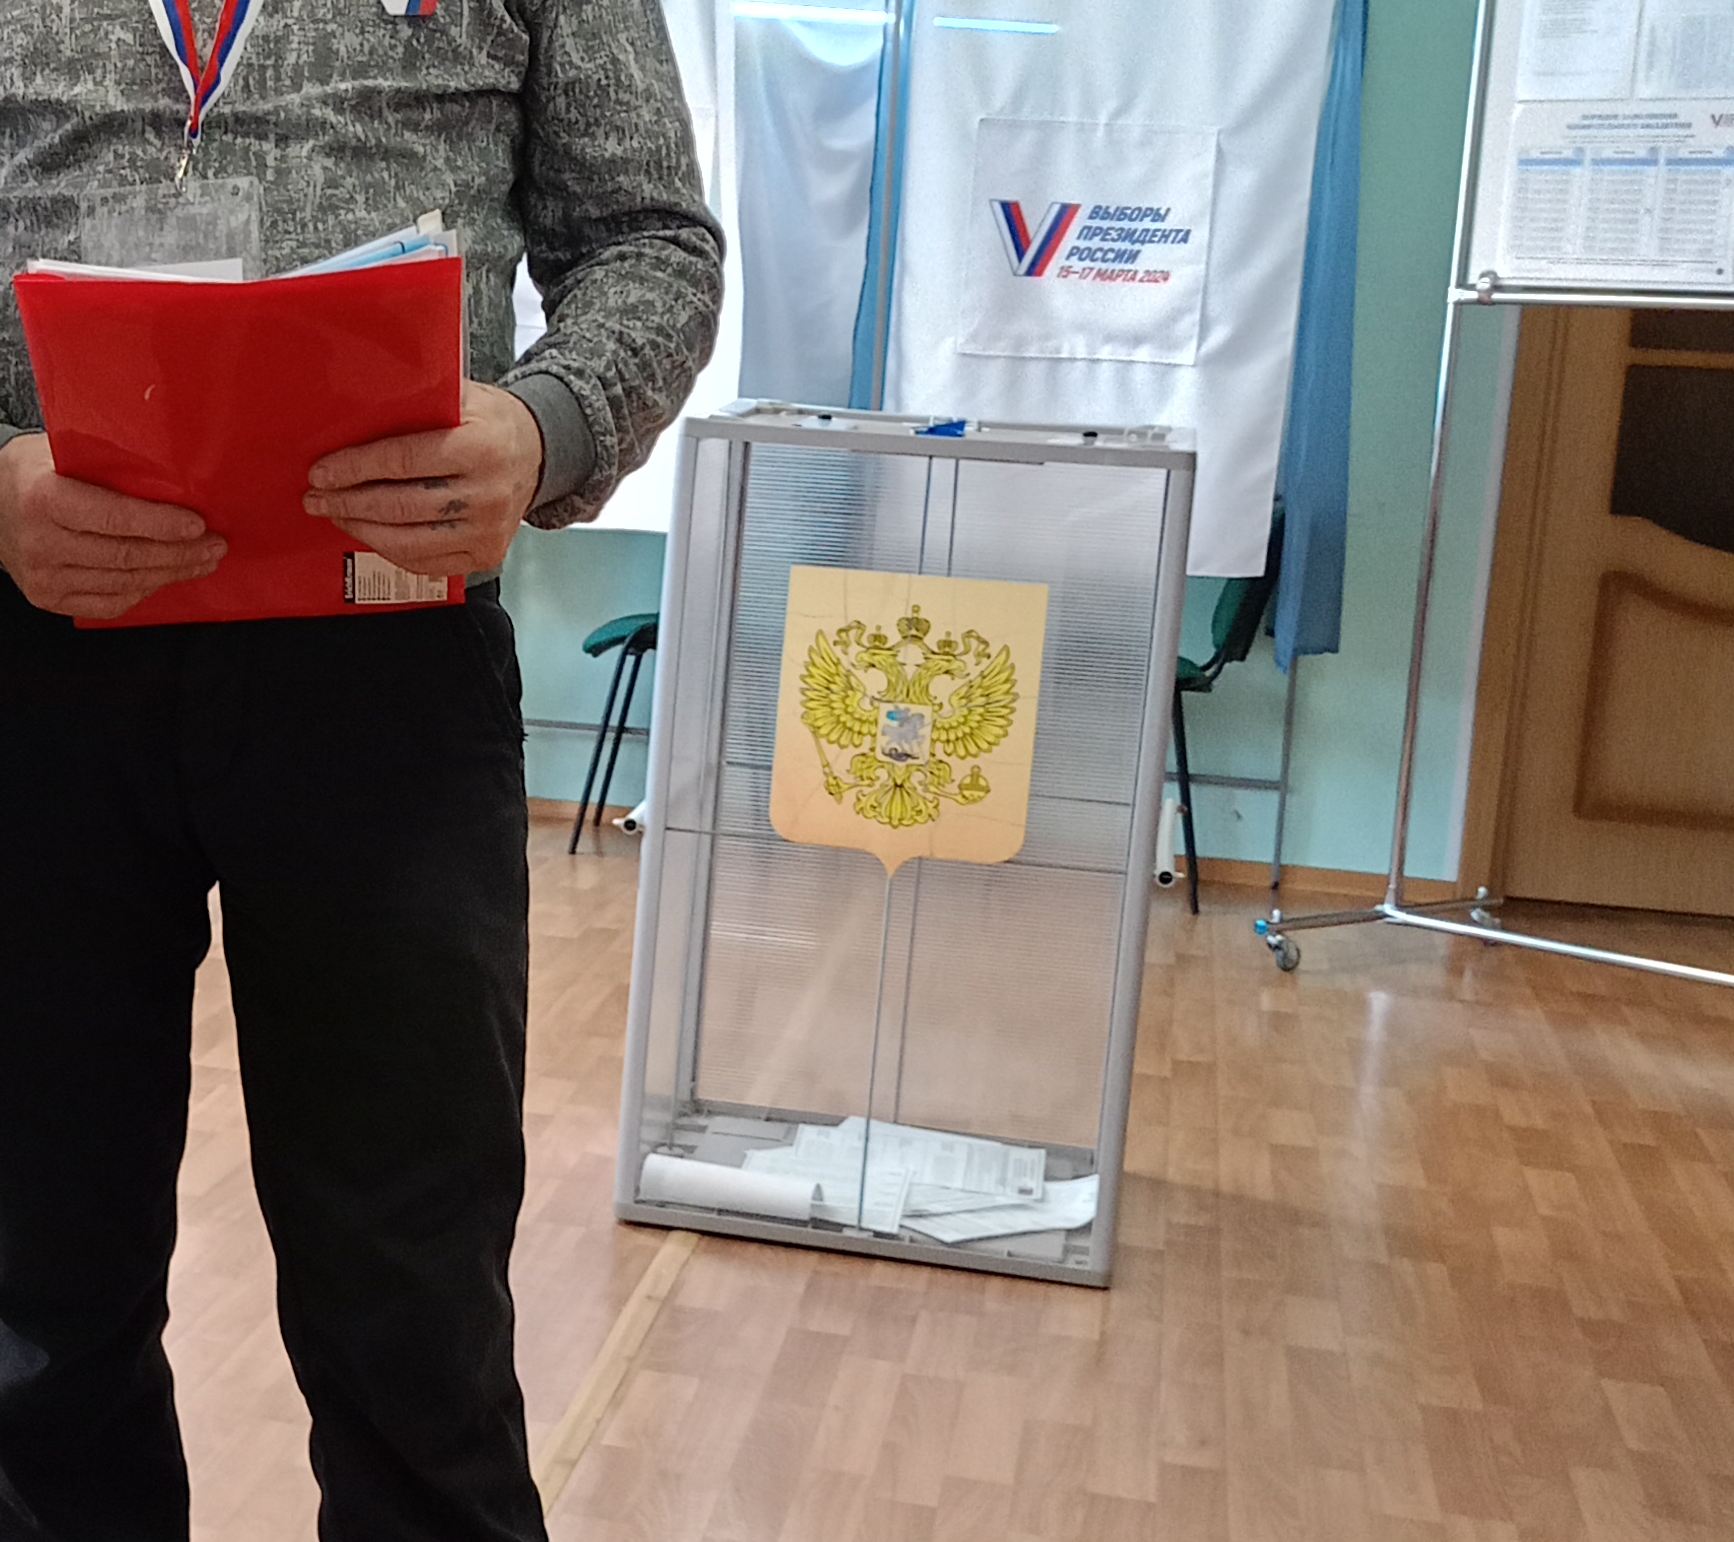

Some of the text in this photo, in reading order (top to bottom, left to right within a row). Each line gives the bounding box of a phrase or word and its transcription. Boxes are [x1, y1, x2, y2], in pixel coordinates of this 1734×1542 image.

[1087, 204, 1171, 223] ВЫБОРЫ
[989, 199, 1082, 277] V
[1076, 225, 1192, 246] ПРЕЗИДЕНТА
[1064, 246, 1142, 265] РОССИИ
[1092, 268, 1139, 282] МАРТА
[1138, 270, 1171, 284] 2024
